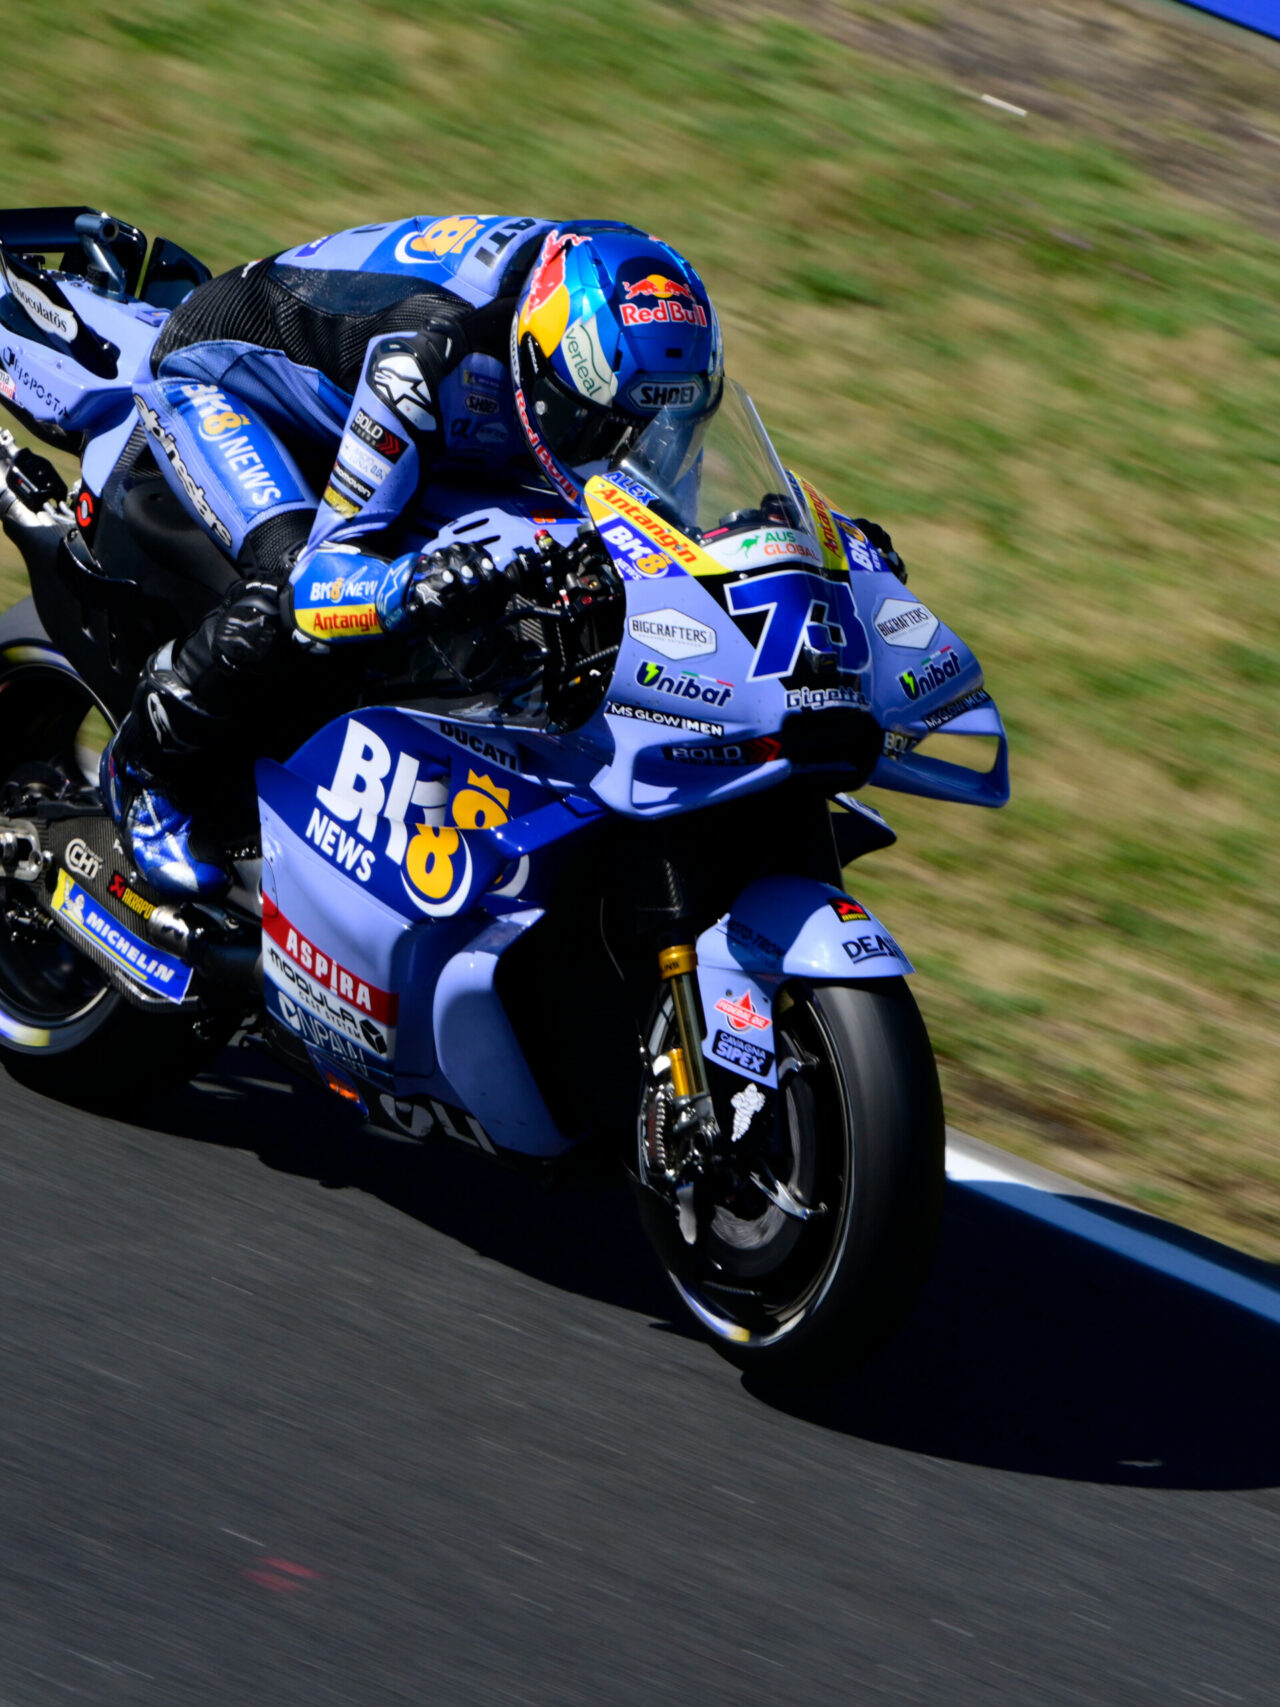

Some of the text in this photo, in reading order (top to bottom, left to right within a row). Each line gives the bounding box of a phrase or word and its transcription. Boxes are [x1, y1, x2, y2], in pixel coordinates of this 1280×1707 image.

[620, 299, 707, 327] Red Bull
[564, 327, 602, 397] verleal
[640, 386, 694, 406] SHOEI
[354, 410, 384, 440] BOLD
[181, 383, 281, 505] BK8 NEWS
[603, 471, 659, 507] ALEX
[592, 487, 697, 564] Antangin
[765, 531, 797, 543] AUS
[601, 525, 670, 577] BK8
[764, 543, 821, 562] GLOBAL
[310, 577, 379, 604] BK8 NEW
[631, 619, 708, 644] BIGCRAFTERS
[723, 569, 873, 683] 73
[877, 608, 929, 637] BIGCRAFTERS
[636, 661, 732, 707] Unibat
[898, 651, 961, 701] Unibat
[610, 705, 723, 737] MS GLOW MEN
[439, 720, 517, 771] DUCATI
[671, 745, 742, 760] BOLD
[305, 807, 376, 882] NEWS
[121, 887, 156, 920] AKRAPO
[86, 911, 175, 983] MICHELIN
[285, 927, 372, 1012] ASPIRA
[719, 1000, 753, 1022] FEDERAL
[718, 1042, 765, 1074] SIPEX
